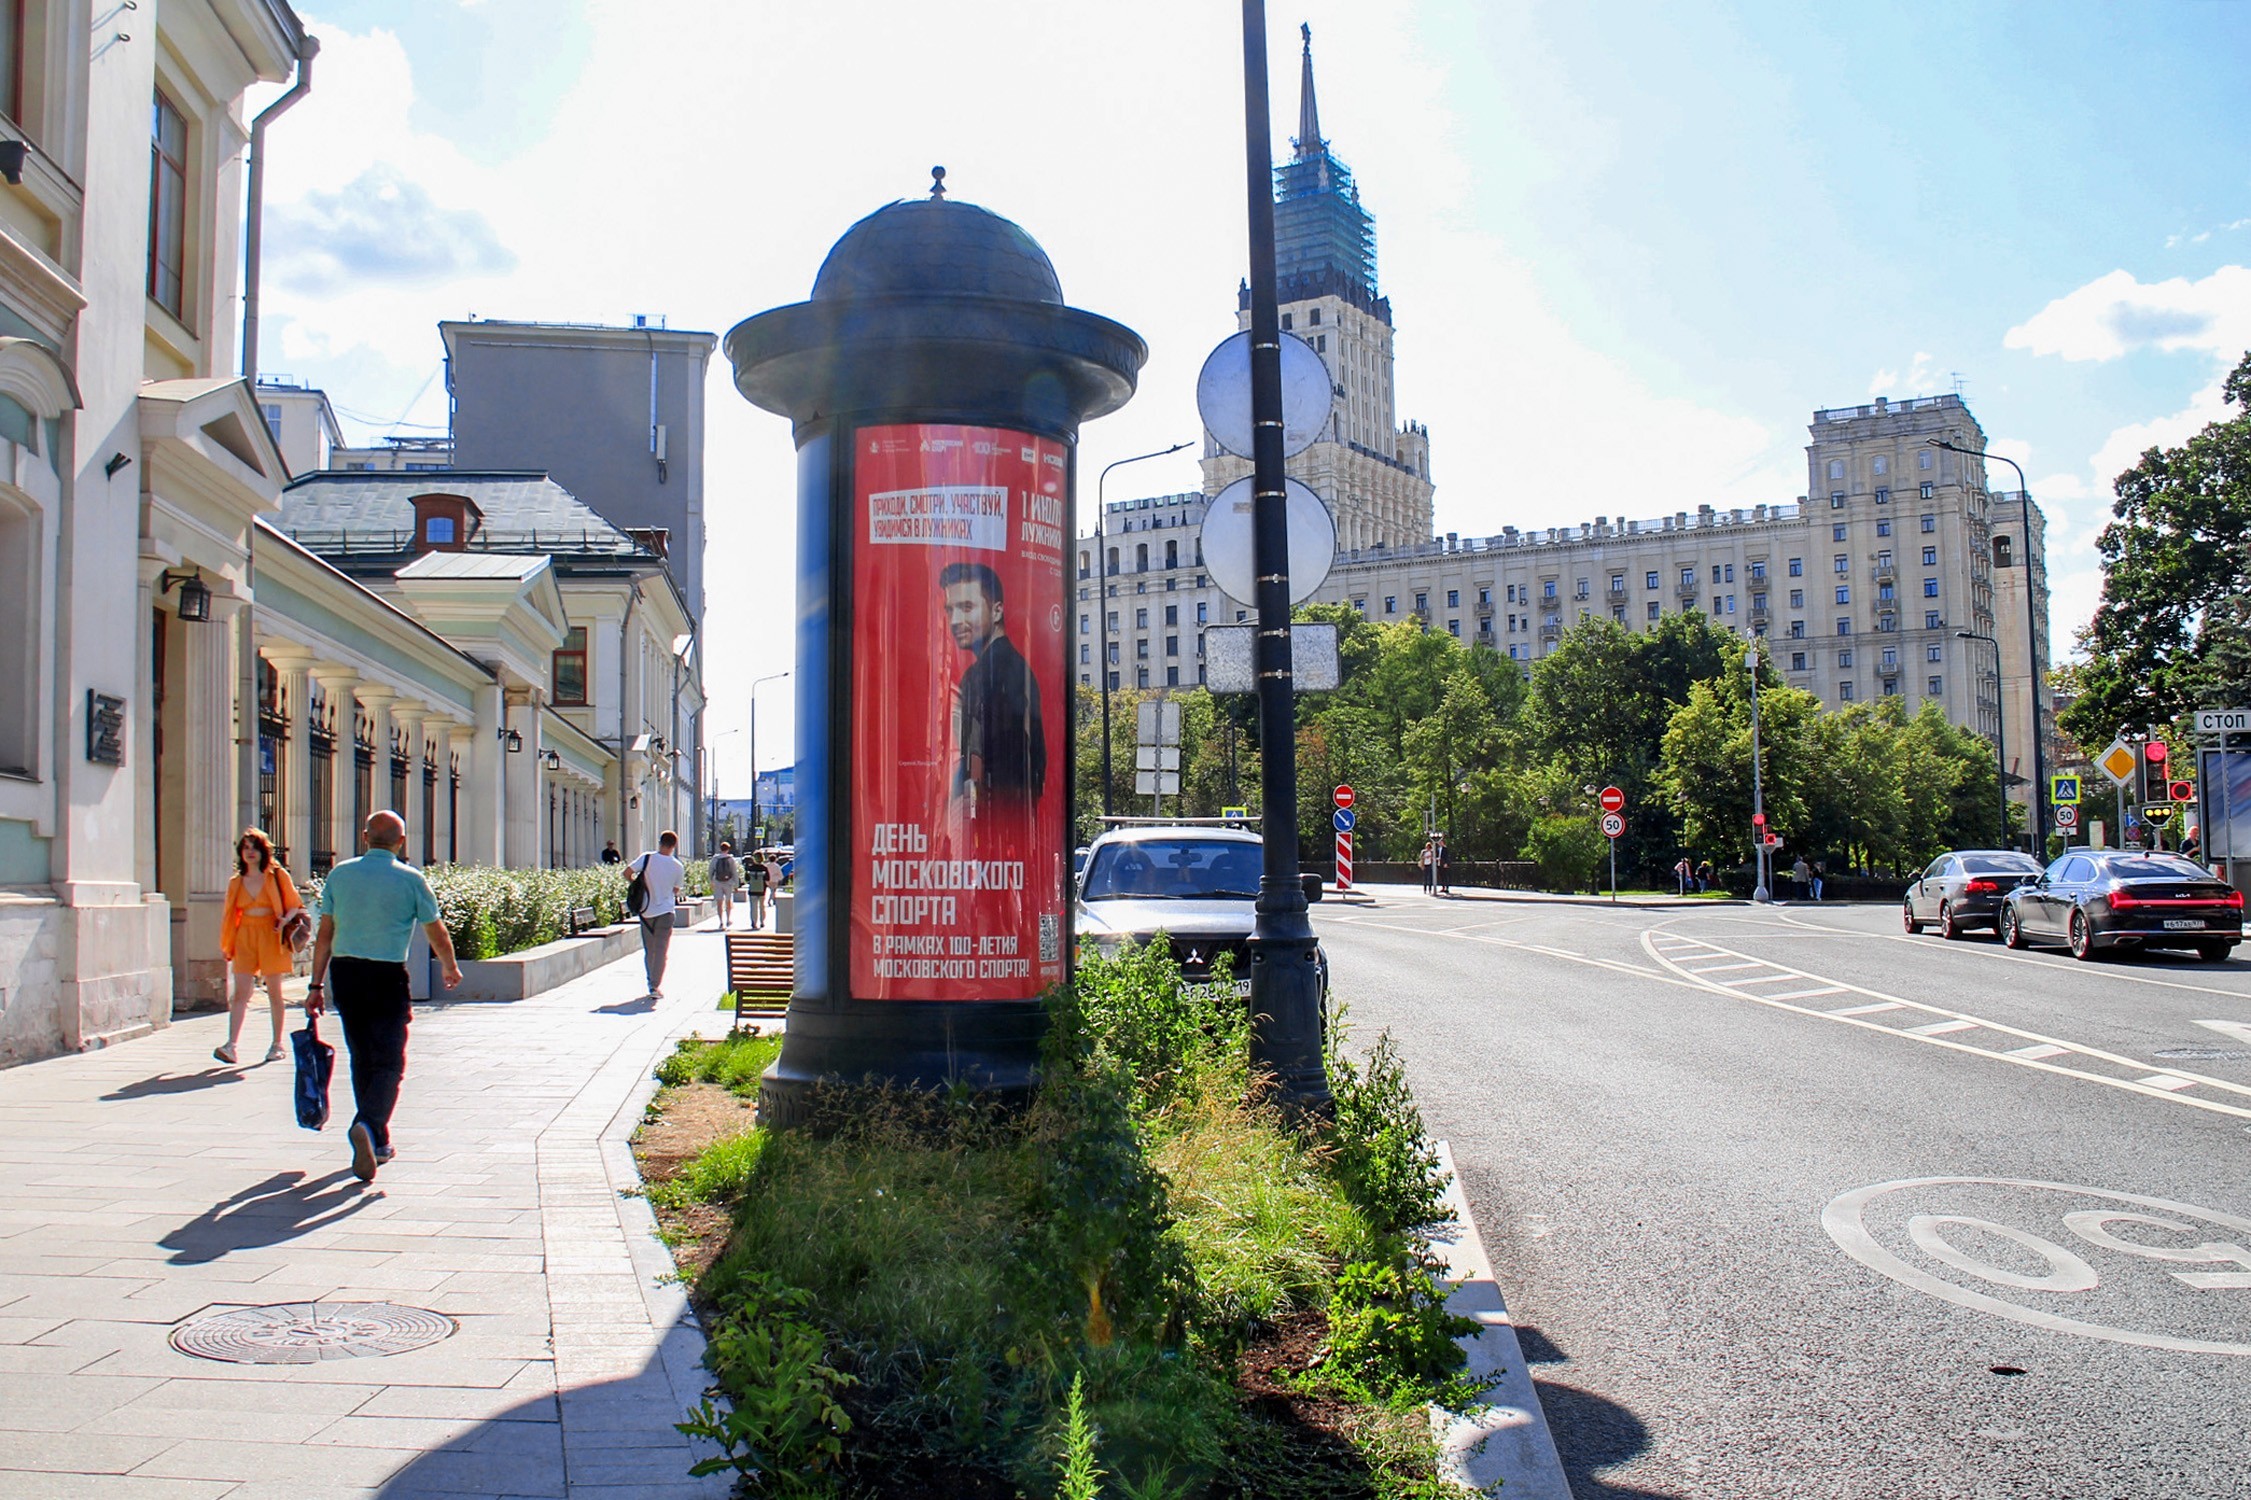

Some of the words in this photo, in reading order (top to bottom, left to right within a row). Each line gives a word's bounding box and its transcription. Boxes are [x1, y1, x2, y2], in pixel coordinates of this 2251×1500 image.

[873, 496, 908, 517] ПРИХОДИ,
[951, 491, 1004, 519] УЧАСТВУЙ,
[1022, 490, 1027, 519] 1
[874, 519, 912, 539] УВИДИМСЯ
[914, 519, 920, 537] В
[922, 519, 973, 540] ЛУЖНИКАХ
[2203, 714, 2246, 729] СТОП
[1606, 820, 1620, 830] 50
[2059, 811, 2072, 821] 50
[871, 823, 928, 856] ДЕНЬ
[872, 860, 1024, 890] МОСКОВСКОГО
[871, 895, 956, 925] СПОРТА
[873, 935, 881, 954] В
[885, 936, 945, 955] РАМКАХ
[949, 936, 1018, 955] 100-ЛЕТИЯ
[873, 958, 976, 979] МОСКОВСКОГО
[979, 958, 1030, 979] СПОРТА!
[1238, 979, 1252, 994] 19
